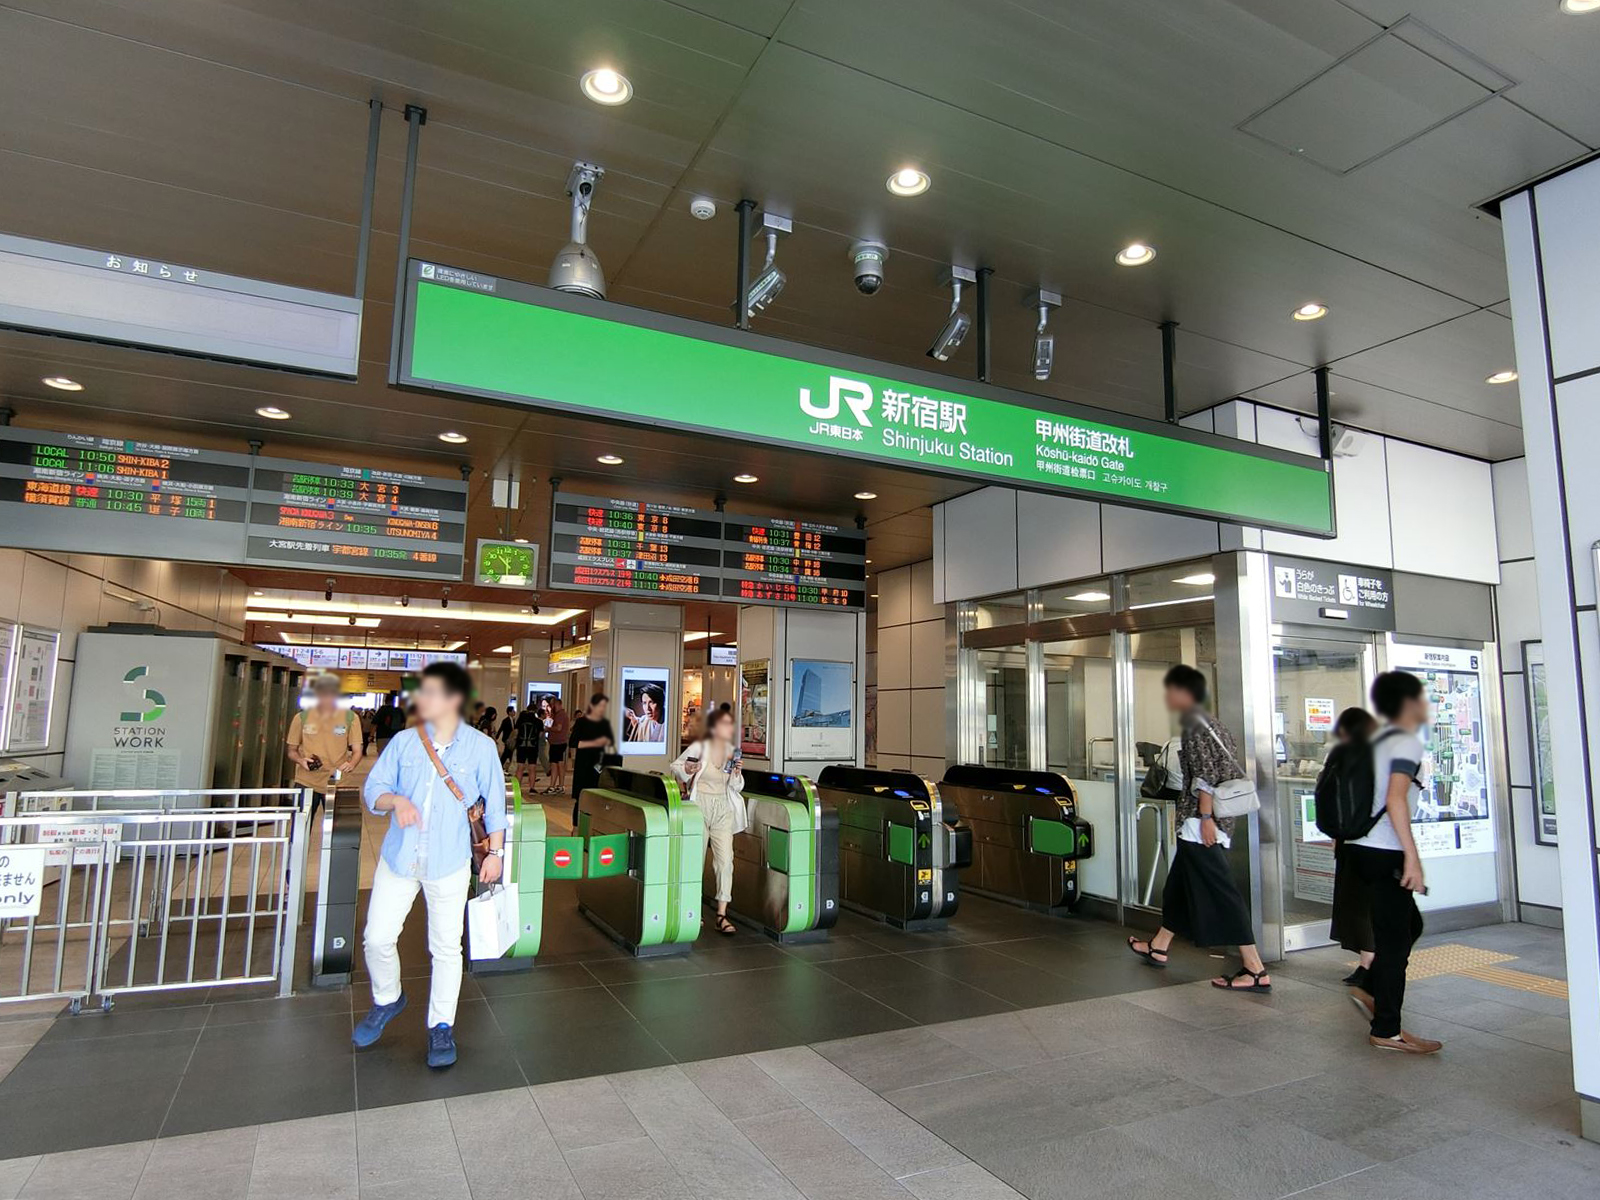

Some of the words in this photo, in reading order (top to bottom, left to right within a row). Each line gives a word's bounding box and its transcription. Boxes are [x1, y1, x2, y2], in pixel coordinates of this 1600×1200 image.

[107, 255, 198, 282] お知らせ
[799, 375, 873, 428] JR
[881, 388, 967, 436] 新宿駅
[809, 422, 864, 442] JR東日本
[1036, 419, 1134, 458] 甲州街道改札
[882, 428, 954, 457] Shinjuku
[959, 442, 1013, 467] Station
[36, 446, 69, 458] LOCAL
[79, 450, 116, 462] 10:50
[117, 455, 160, 467] SHIN-KIBA
[161, 459, 170, 469] 2
[1101, 457, 1125, 471] Gate
[35, 457, 68, 469] LOCAL
[78, 462, 115, 474] 11:06
[116, 466, 159, 478] SHIN-KIBA
[161, 469, 168, 479] 1
[323, 478, 355, 490] 10:33
[391, 485, 399, 494] 3
[26, 481, 72, 495] 東海道線
[75, 486, 98, 498] 快速
[107, 489, 144, 502] 10:30
[207, 499, 216, 508] 1
[322, 488, 353, 499] 10:39
[390, 495, 398, 504] 4
[25, 491, 70, 506] 横須賀線
[75, 497, 97, 508] 普通
[106, 500, 142, 512] 10:45
[208, 510, 215, 519] 1
[327, 510, 335, 520] 3
[608, 510, 634, 520] 10:36
[662, 516, 668, 525] 8
[346, 523, 377, 535] 10:35
[430, 532, 438, 540] 4
[608, 520, 633, 530] 10:40
[662, 525, 668, 534] 8
[769, 530, 790, 539] 10:31
[269, 539, 330, 552] 大宮駅先着列車
[332, 544, 369, 557] 宇都宮線
[607, 539, 631, 549] 10:31
[660, 545, 668, 553] 13
[769, 539, 790, 547] 10:37
[607, 548, 632, 559] 10:37
[660, 554, 668, 562] 13
[769, 557, 790, 565] 10:30
[634, 571, 658, 581] 10:40
[1296, 568, 1314, 580] うらが
[634, 581, 658, 590] 11:10
[797, 587, 818, 595] 10:30
[1297, 582, 1336, 596] 白色のきっぷ
[797, 595, 818, 603] 11:00
[1358, 590, 1388, 603] ご利用の方
[114, 727, 166, 736] STATION
[114, 736, 164, 748] WORK
